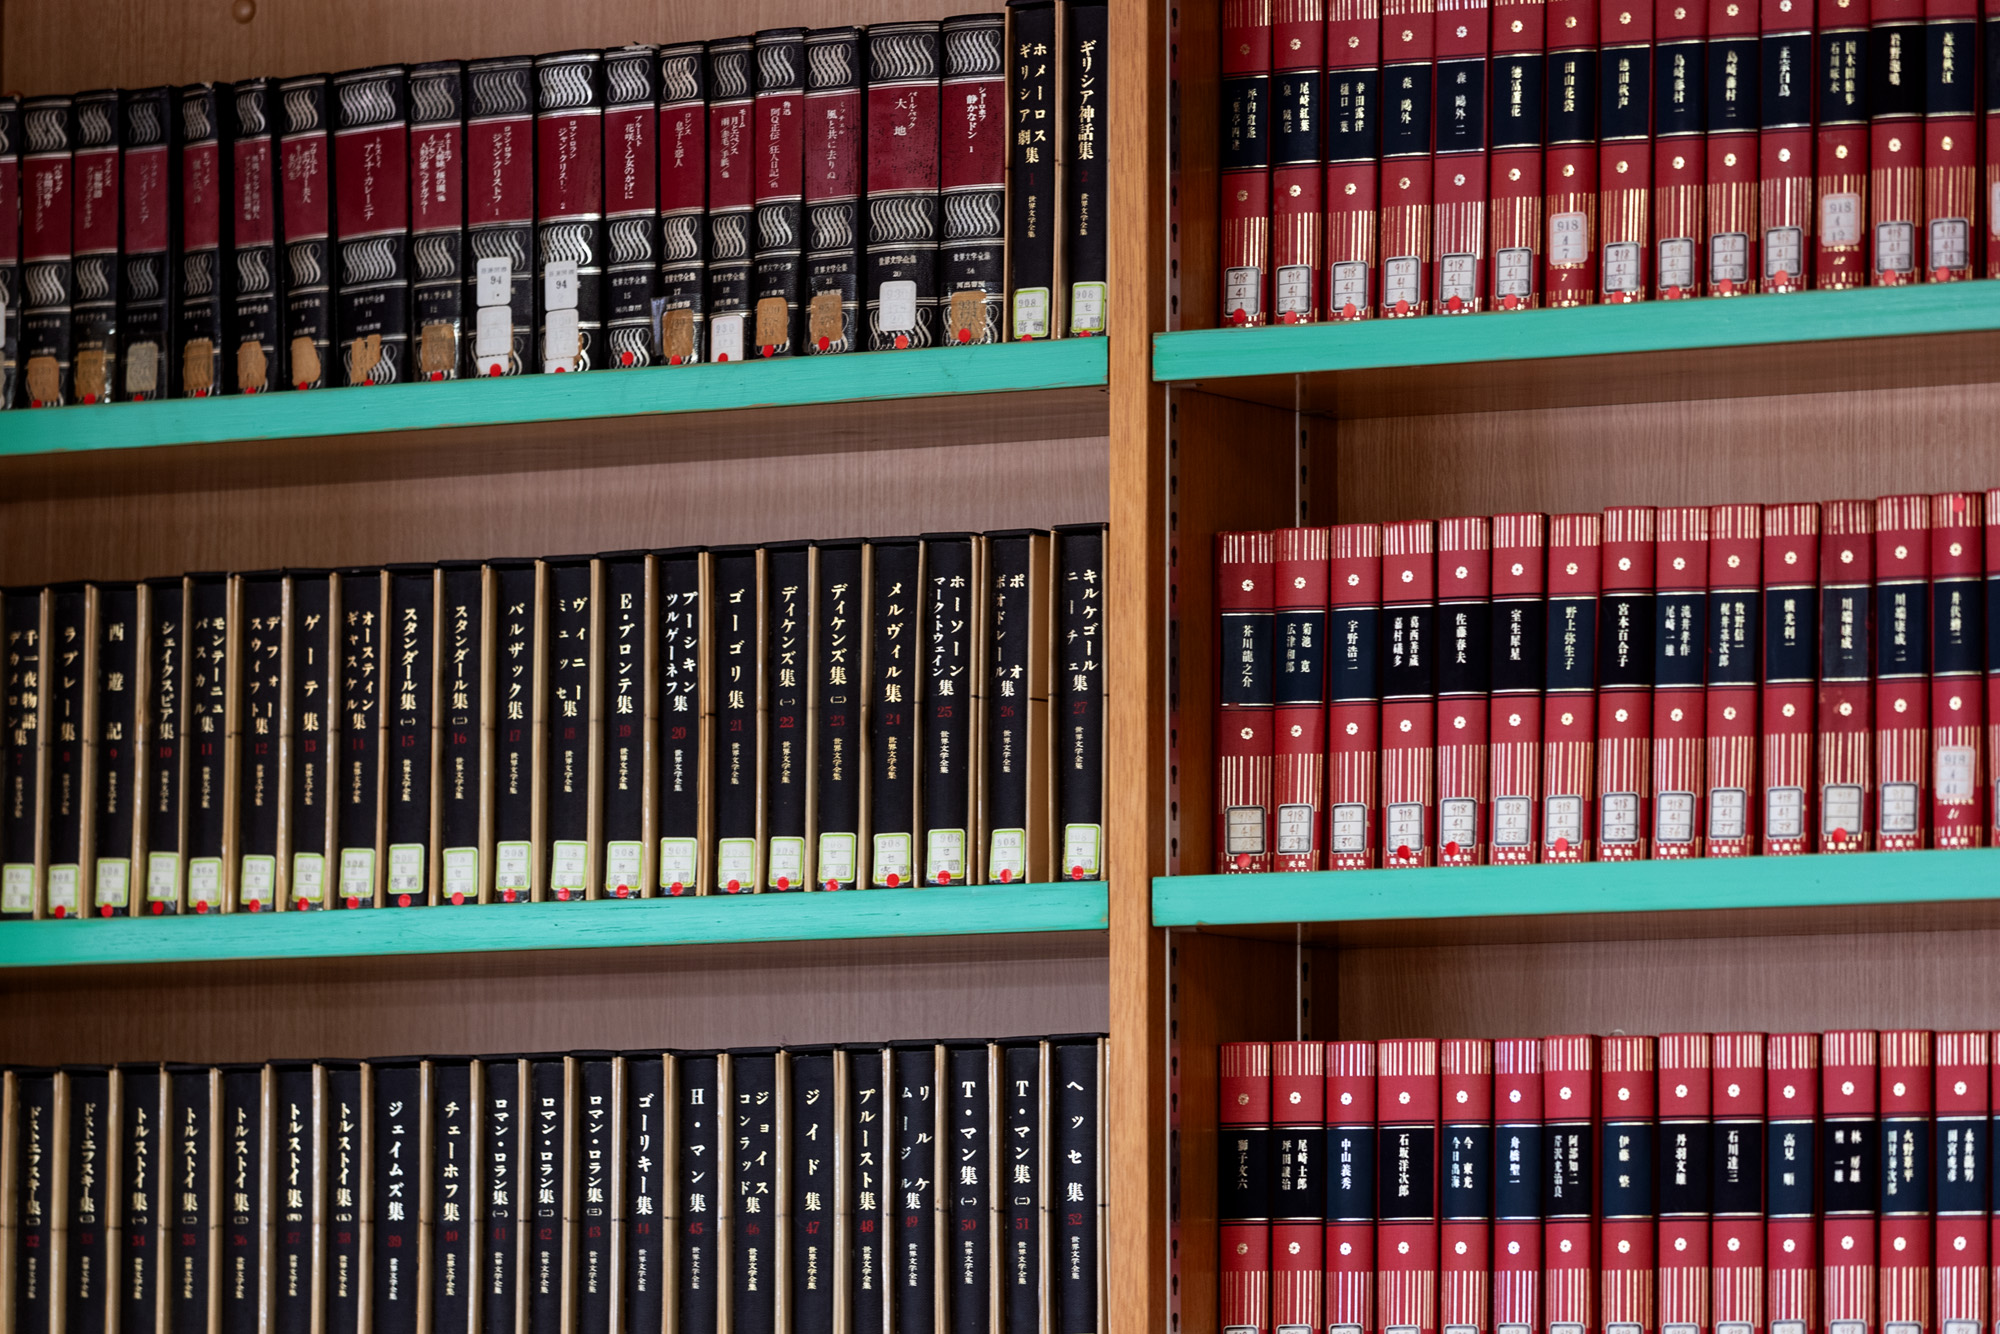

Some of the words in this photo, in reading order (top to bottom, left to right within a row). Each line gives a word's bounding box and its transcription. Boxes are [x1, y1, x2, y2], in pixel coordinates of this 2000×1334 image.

[894, 99, 909, 136] 大地
[967, 92, 980, 138] 静かなドン
[1034, 44, 1046, 141] ホメーロス
[1079, 40, 1096, 160] ギリシア神話集
[1300, 82, 1309, 131] 尾崎紅葉
[1340, 83, 1349, 132] 樋口一葉
[1355, 83, 1364, 131] 幸田露伴
[1564, 62, 1575, 112] 田山花袋
[633, 116, 642, 146] プルースト
[675, 119, 686, 167] 息子と恋人
[683, 113, 691, 135] ロレンス
[827, 110, 837, 179] 風と共に去りぬ
[364, 144, 374, 221] アンナ・カレーニナ
[492, 134, 502, 202] ジャン・クリストフ
[624, 123, 637, 199] 花咲く乙女のかげに
[1028, 196, 1036, 237] 世界文学全集
[1080, 193, 1089, 235] 世界文学全集
[1556, 219, 1579, 231] 918
[490, 276, 502, 284] 94
[556, 280, 567, 288] 94
[556, 600, 571, 702] ミュッセ
[570, 597, 587, 702] ヴィニー
[666, 594, 681, 697] ツルゲーネフ
[681, 589, 700, 696] プーシキン
[729, 589, 744, 709] ゴーゴリ集
[885, 583, 903, 702] メルヴィル集
[933, 577, 945, 676] マーク・トウェイン
[950, 576, 964, 676] ホーソーン
[997, 575, 1006, 676] ボオドレール
[1007, 574, 1024, 681] ポオ
[1067, 572, 1079, 670] ニーチェ
[1082, 569, 1098, 671] キルケゴール
[1286, 623, 1296, 672] 広津和郎
[1301, 623, 1312, 672] 菊池寛
[1347, 620, 1358, 669] 宇野浩二
[1409, 616, 1419, 666] 葛西善蔵
[1456, 613, 1467, 663] 佐藤春夫
[1511, 609, 1521, 660] 室生犀星
[1565, 607, 1577, 670] 野上弥生子
[1618, 603, 1629, 667] 宮本百合子
[10, 632, 23, 730] デカメロン
[20, 630, 40, 732] 千一夜物語
[62, 627, 78, 741] ラブレー集
[107, 623, 123, 740] 西遊記
[161, 622, 175, 739] シェイクスピア集
[196, 618, 209, 717] パスカル
[211, 618, 227, 716] モンテーニュ
[251, 618, 264, 720] スウィフト
[267, 614, 283, 719] デフォー
[304, 615, 320, 731] ゲーテ集
[347, 612, 358, 709] ギャスケル
[363, 612, 374, 710] オースティン
[509, 603, 524, 719] バルザック集
[617, 594, 635, 714] E・ブロンテ集
[1242, 625, 1253, 687] 芥川龍之介
[402, 735, 414, 747] 15
[454, 733, 466, 744] 16
[672, 727, 686, 739] 20
[780, 716, 794, 728] 22
[886, 714, 900, 724] 24
[938, 706, 952, 717] 25
[1001, 706, 1014, 717] 26
[1073, 702, 1087, 714] 27
[674, 750, 682, 791] 世界文学全集
[1075, 727, 1083, 769] 世界文学全集
[388, 1101, 404, 1221] ジェイムズ集
[444, 1102, 460, 1221] チェーホフ集
[637, 1093, 654, 1215] ゴーリキー集
[690, 1089, 706, 1212] H・マン集
[740, 1094, 753, 1198] コンラッド
[756, 1092, 769, 1193] ジョイス
[806, 1089, 821, 1211] ジイド集
[860, 1089, 876, 1210] プルースト集
[902, 1087, 912, 1188] ムージル
[913, 1086, 932, 1193] リルケ
[1067, 1082, 1084, 1202] ヘッセ集
[1238, 1140, 1248, 1188] 獅子文六
[1297, 1140, 1307, 1189] 尾崎士郎
[1341, 1139, 1351, 1189] 中山義秀
[1399, 1134, 1409, 1196] 石坂洋次郎
[1452, 1137, 1460, 1188] 今日出海
[689, 1223, 703, 1234] 45
[806, 1221, 820, 1234] 47
[962, 1220, 976, 1231] 50
[1068, 1213, 1082, 1225] 52
[1071, 1236, 1080, 1279] 世界文学全集
